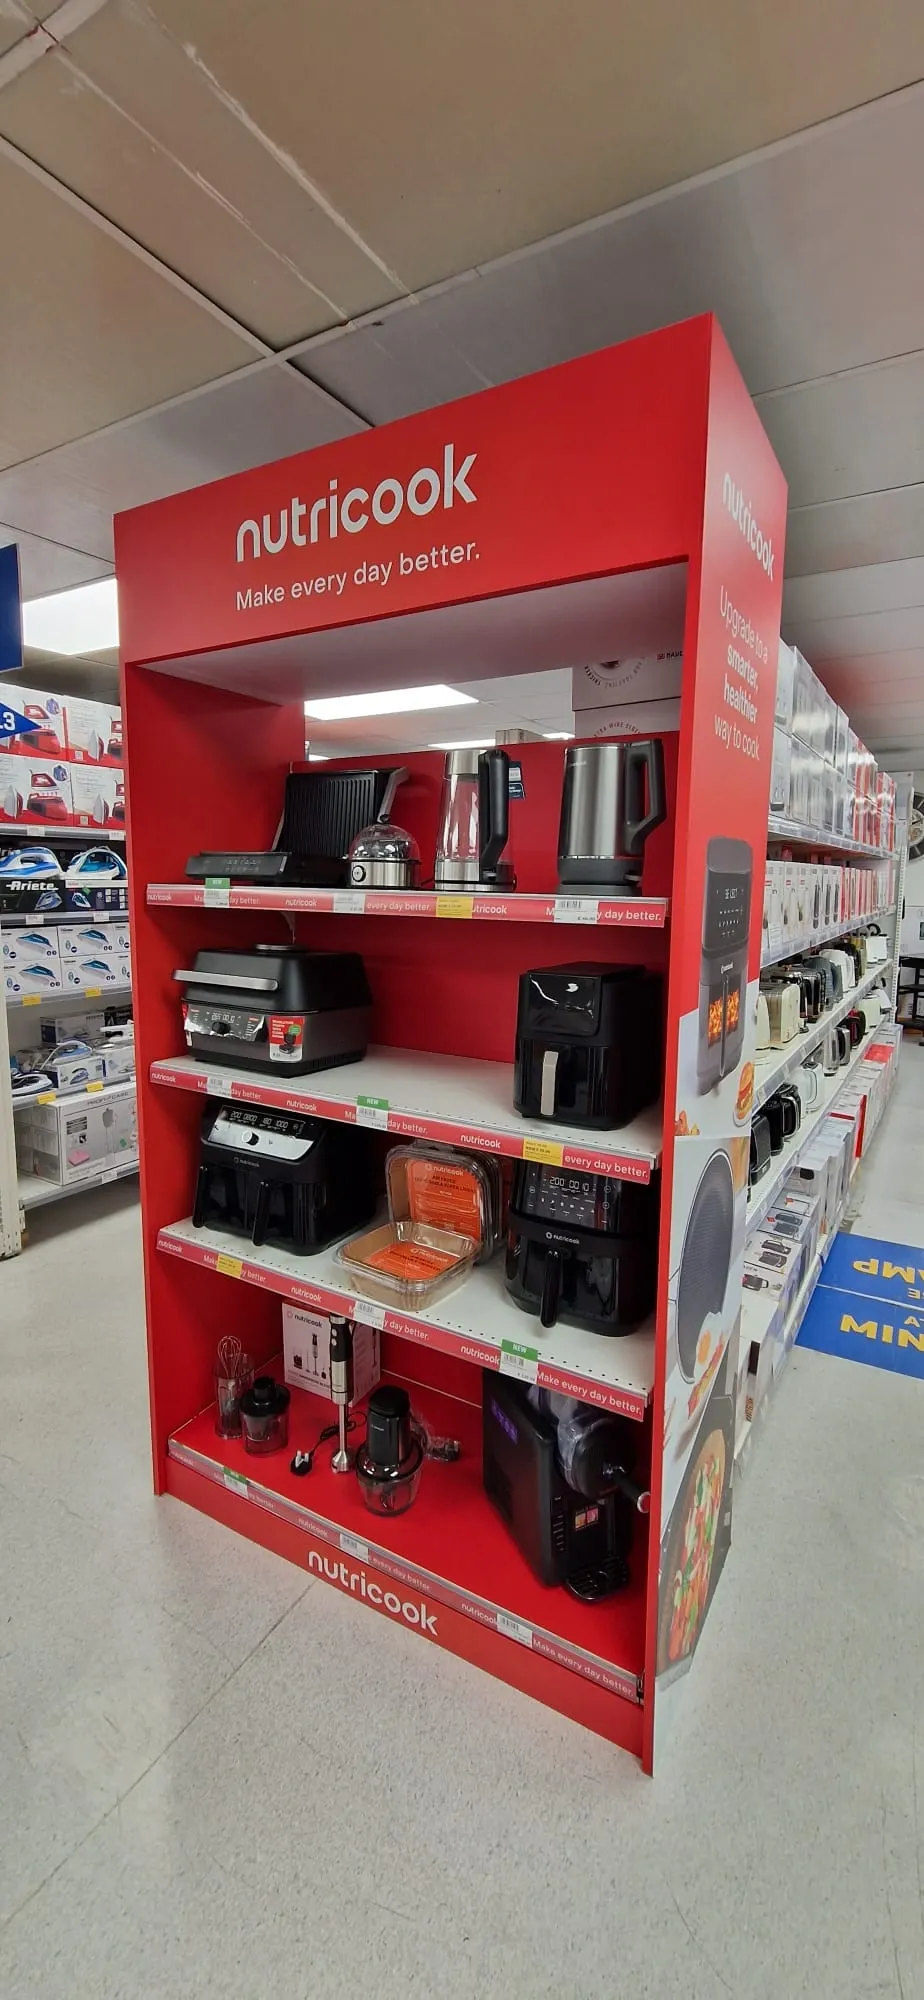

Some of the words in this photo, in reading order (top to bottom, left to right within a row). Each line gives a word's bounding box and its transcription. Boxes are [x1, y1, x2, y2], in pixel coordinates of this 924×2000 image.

[235, 443, 478, 562] nutricook
[722, 471, 775, 582] nutricook
[235, 584, 285, 611] Make
[291, 570, 347, 599] every
[353, 561, 393, 588] day
[399, 540, 480, 576] better.
[720, 584, 755, 649] Upgrade
[755, 632, 762, 658] to
[763, 646, 768, 665] a
[727, 643, 758, 693] smarter,
[0, 711, 15, 731] 3
[723, 672, 757, 724] healthier
[714, 714, 732, 749] way
[733, 723, 742, 745] to
[742, 731, 760, 760] cook
[6, 880, 58, 891] Ariete
[285, 898, 317, 908] nutricook
[367, 902, 388, 910] every
[389, 901, 404, 911] day
[405, 902, 432, 911] better.
[473, 904, 508, 914] utricook
[604, 909, 624, 922] day
[626, 910, 662, 921] better.
[151, 1072, 176, 1083] nutricook
[286, 1099, 317, 1112] nutricook
[344, 1110, 356, 1120] Ma
[387, 1119, 401, 1129] day
[460, 1134, 501, 1149] nutricook
[564, 1154, 592, 1169] every
[593, 1159, 612, 1173] day
[614, 1162, 648, 1178] better.
[366, 1097, 379, 1105] NEW
[549, 1176, 564, 1187] 200
[553, 1234, 580, 1245] nutricook
[294, 1313, 323, 1329] nutricook
[291, 1286, 322, 1303] nutricook
[389, 1320, 404, 1333] day
[404, 1324, 430, 1341] better.
[460, 1344, 500, 1366] nutricook
[536, 1370, 560, 1386] Make
[561, 1381, 588, 1396] every
[589, 1388, 608, 1405] day
[609, 1395, 642, 1416] better.
[512, 1343, 527, 1353] NEW
[308, 1550, 438, 1636] nutricook
[533, 1639, 556, 1656] Make
[557, 1653, 582, 1671] every
[584, 1663, 601, 1680] day
[602, 1673, 634, 1697] better.
